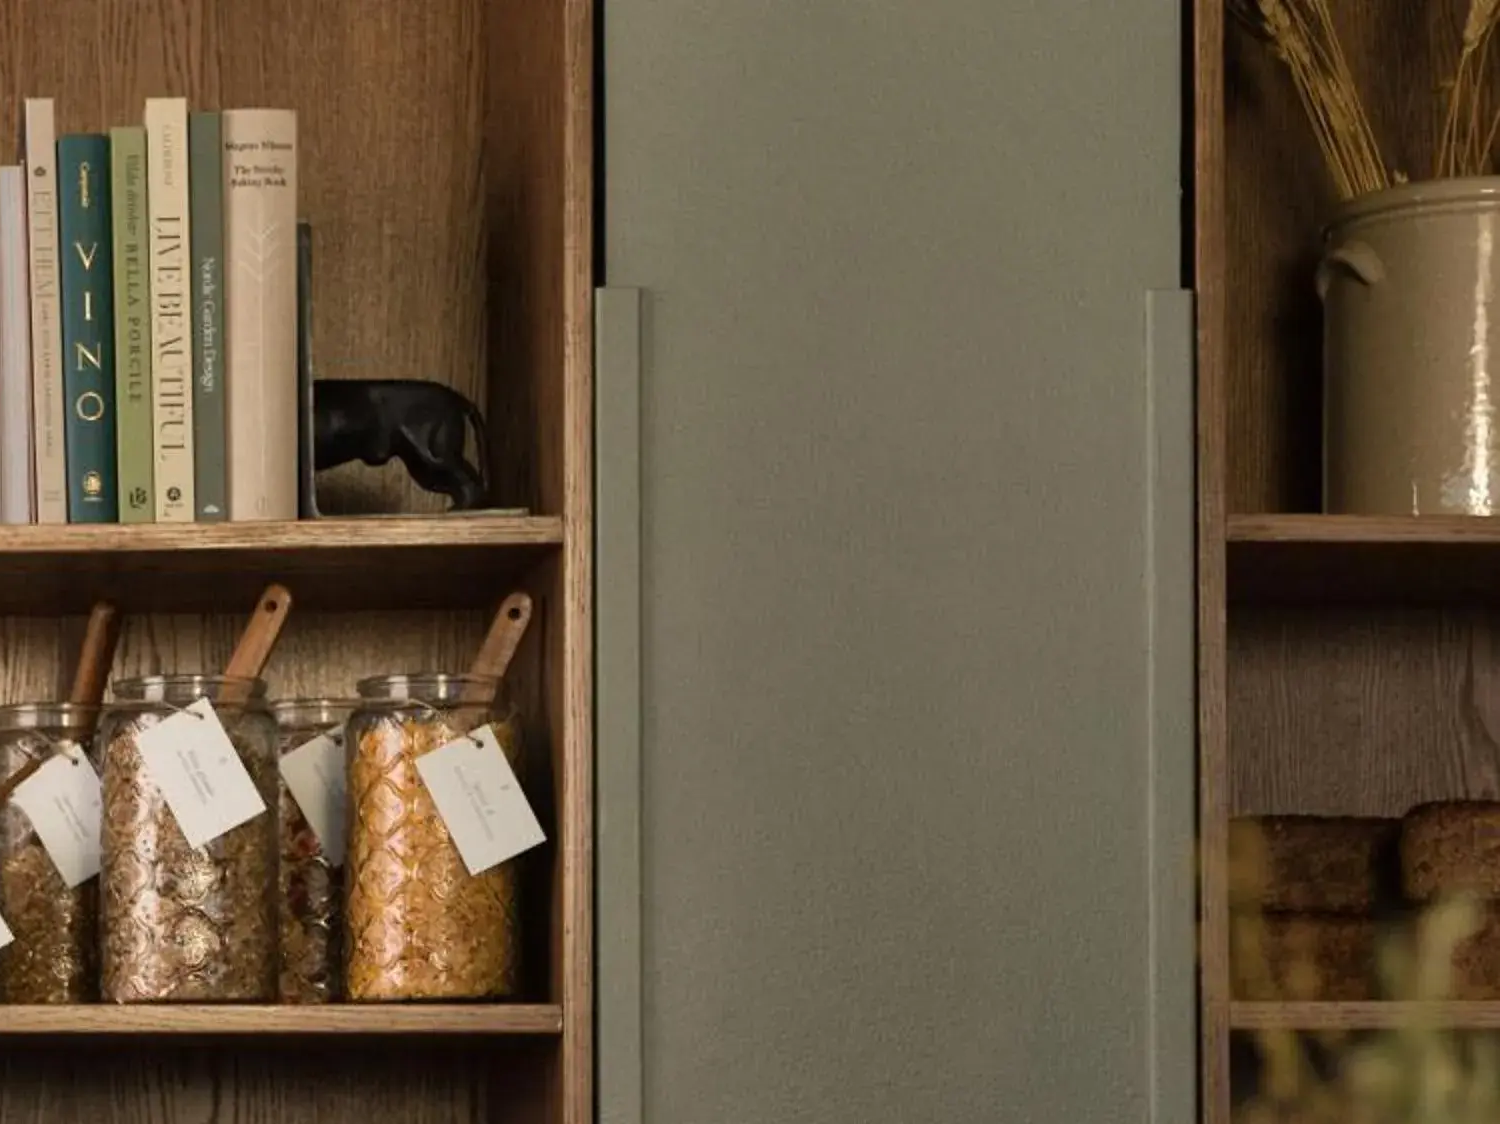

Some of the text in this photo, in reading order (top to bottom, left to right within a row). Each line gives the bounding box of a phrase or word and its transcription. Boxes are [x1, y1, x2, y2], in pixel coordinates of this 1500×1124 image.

[124, 243, 140, 308] BELLA
[155, 216, 183, 283] LIVE
[73, 241, 106, 422] VINO
[127, 316, 144, 404] PORCILE
[156, 290, 188, 462] BEAUTIFUL
[200, 256, 218, 393] Nordic Garden Design
